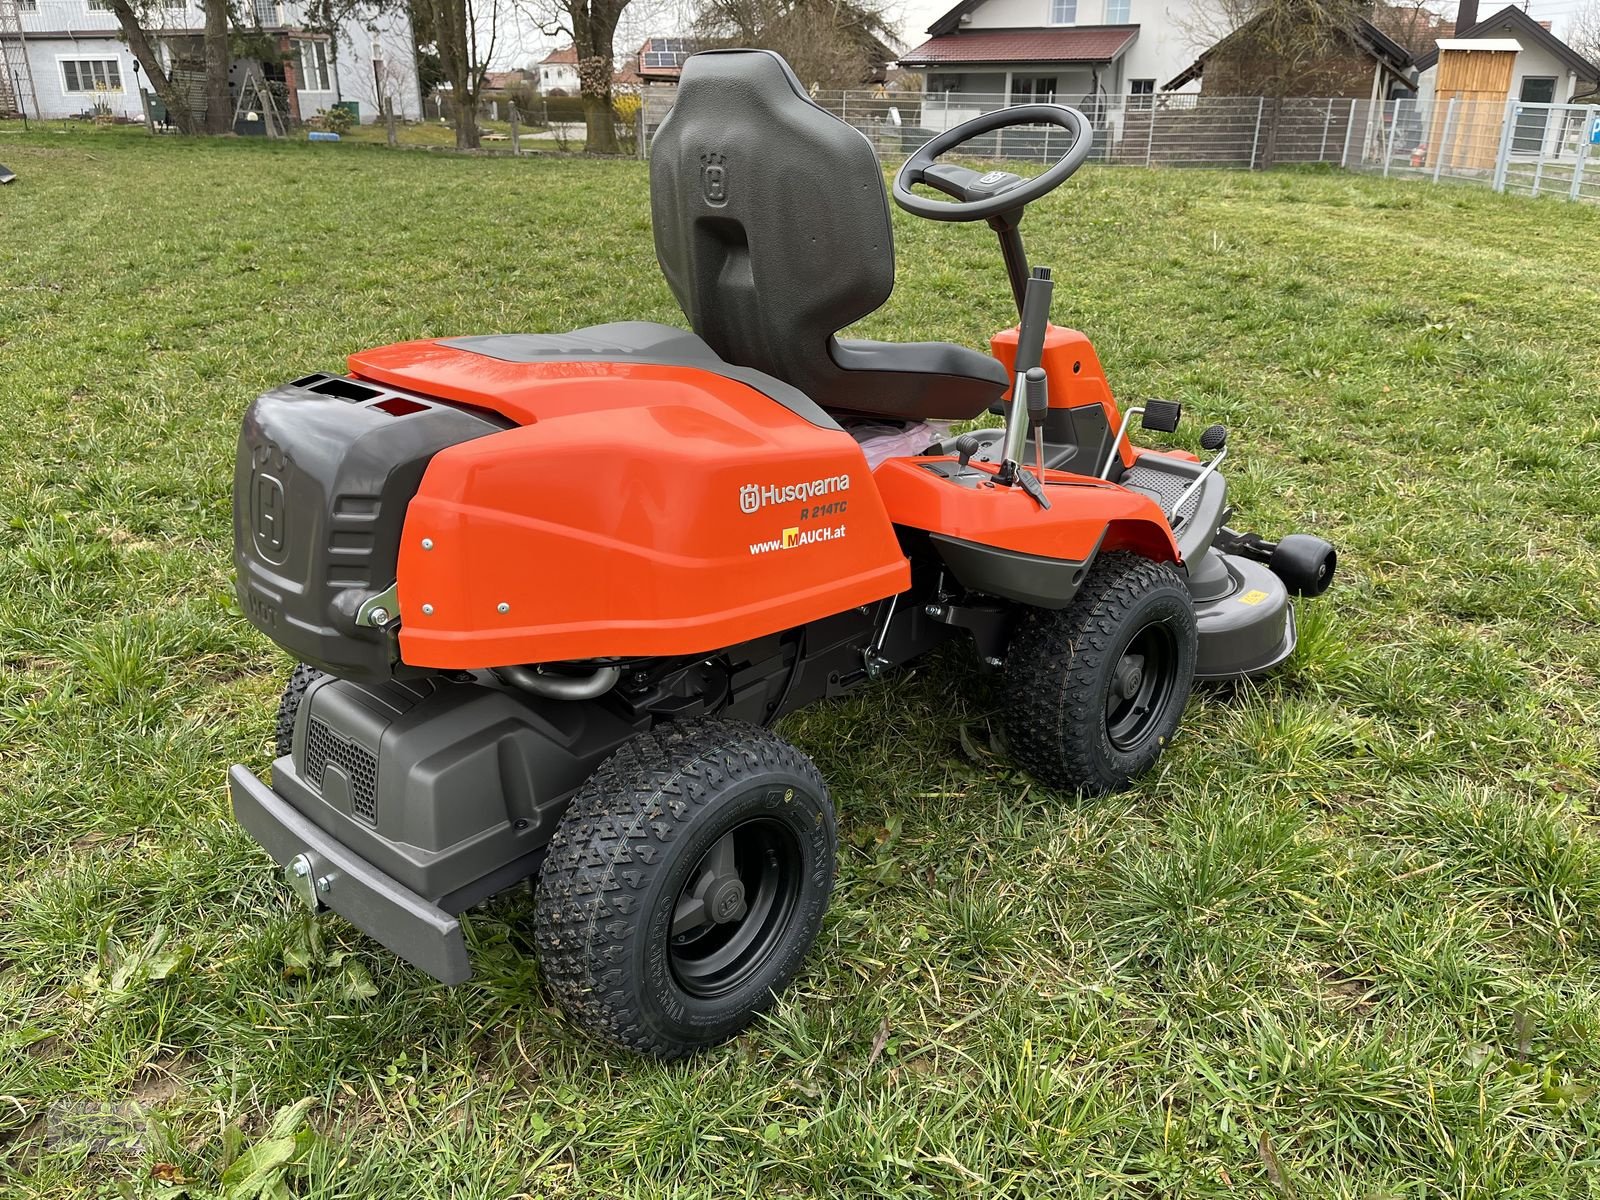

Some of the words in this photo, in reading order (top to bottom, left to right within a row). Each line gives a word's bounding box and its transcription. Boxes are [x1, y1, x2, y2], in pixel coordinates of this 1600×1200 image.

[761, 474, 850, 507] Husqvarna
[800, 508, 809, 520] R
[812, 501, 848, 519] 214TC
[749, 525, 846, 555] www.MAUCH.at
